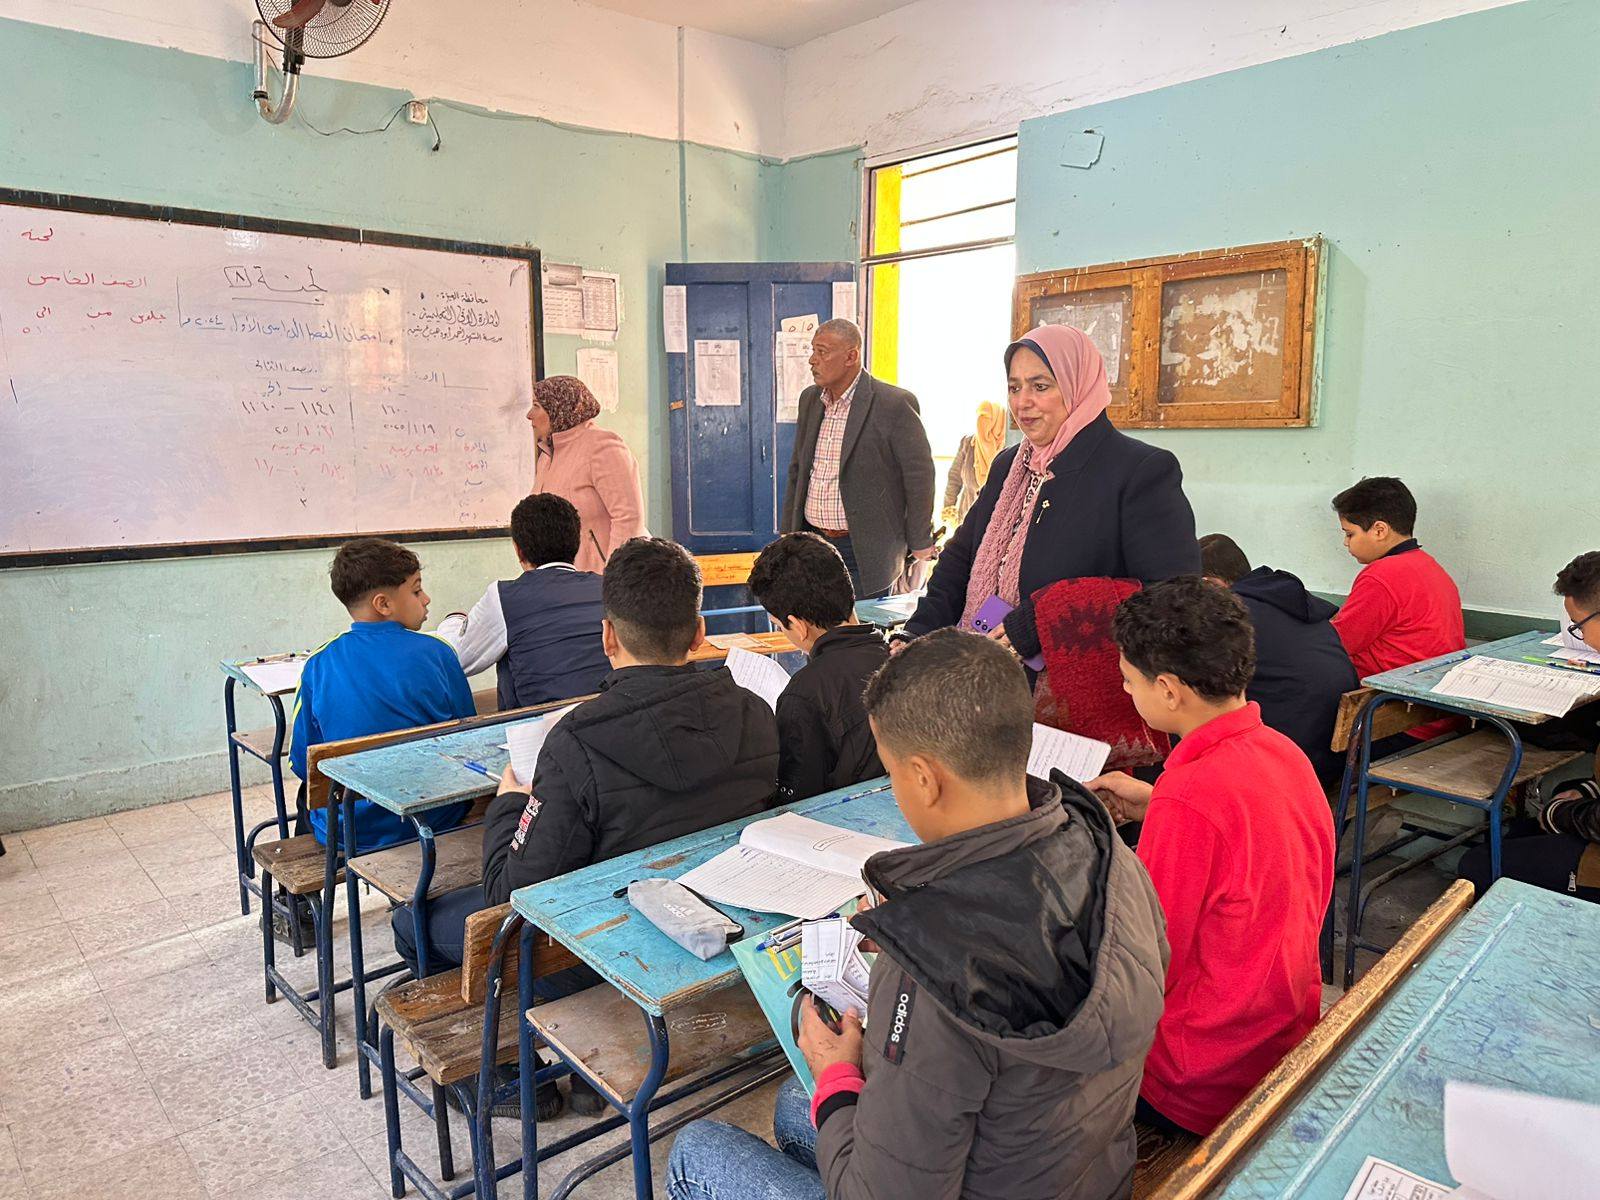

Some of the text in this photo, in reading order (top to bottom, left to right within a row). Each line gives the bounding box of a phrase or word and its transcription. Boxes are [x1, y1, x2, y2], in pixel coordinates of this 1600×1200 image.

[27, 269, 149, 288] الصف الخامس
[253, 264, 329, 302] لجنة
[460, 291, 490, 305] محافظة
[86, 306, 113, 319] من
[305, 319, 341, 342] الفصل
[342, 322, 382, 342] امتحان
[482, 332, 503, 343] مدرسة
[890, 993, 909, 1043] adidas
